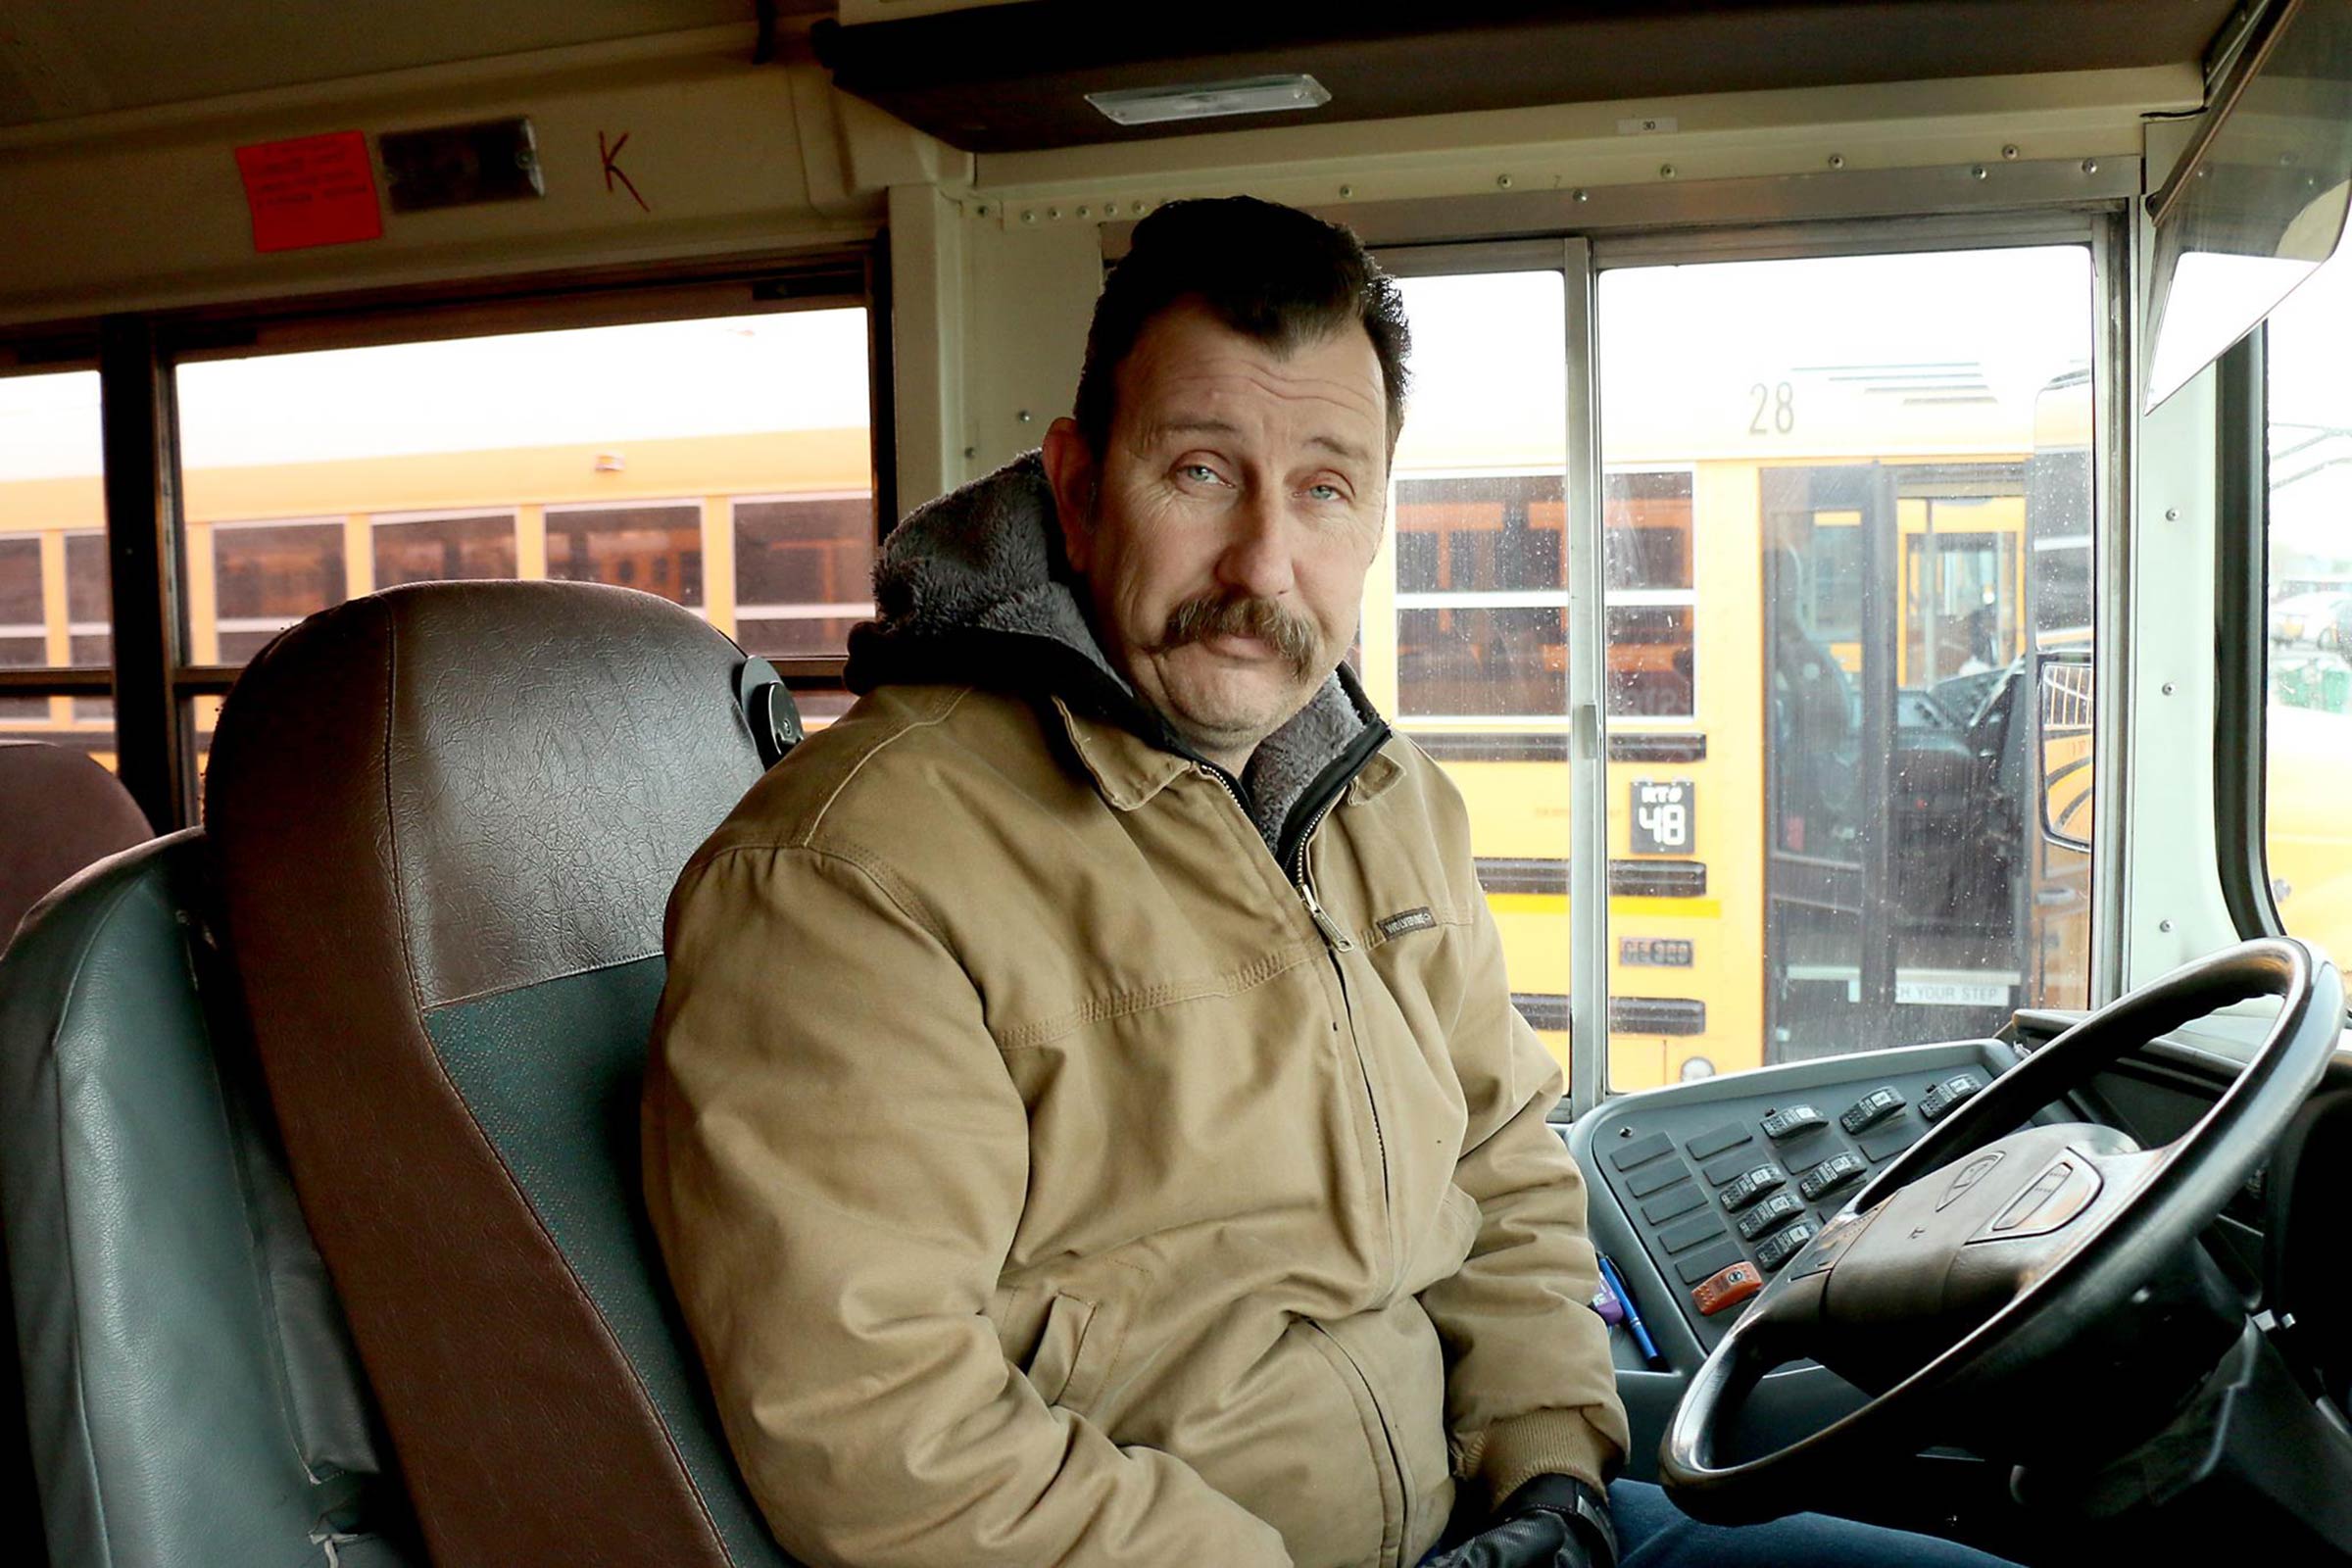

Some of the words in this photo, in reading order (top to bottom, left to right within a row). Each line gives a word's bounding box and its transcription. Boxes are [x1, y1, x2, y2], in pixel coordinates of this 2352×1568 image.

[1642, 121, 1656, 131] 30
[599, 130, 651, 213] K
[1749, 381, 1794, 434] 28
[1639, 804, 1686, 846] 48
[1917, 986, 1956, 1001] YOUR
[1962, 987, 1997, 1003] STEP
